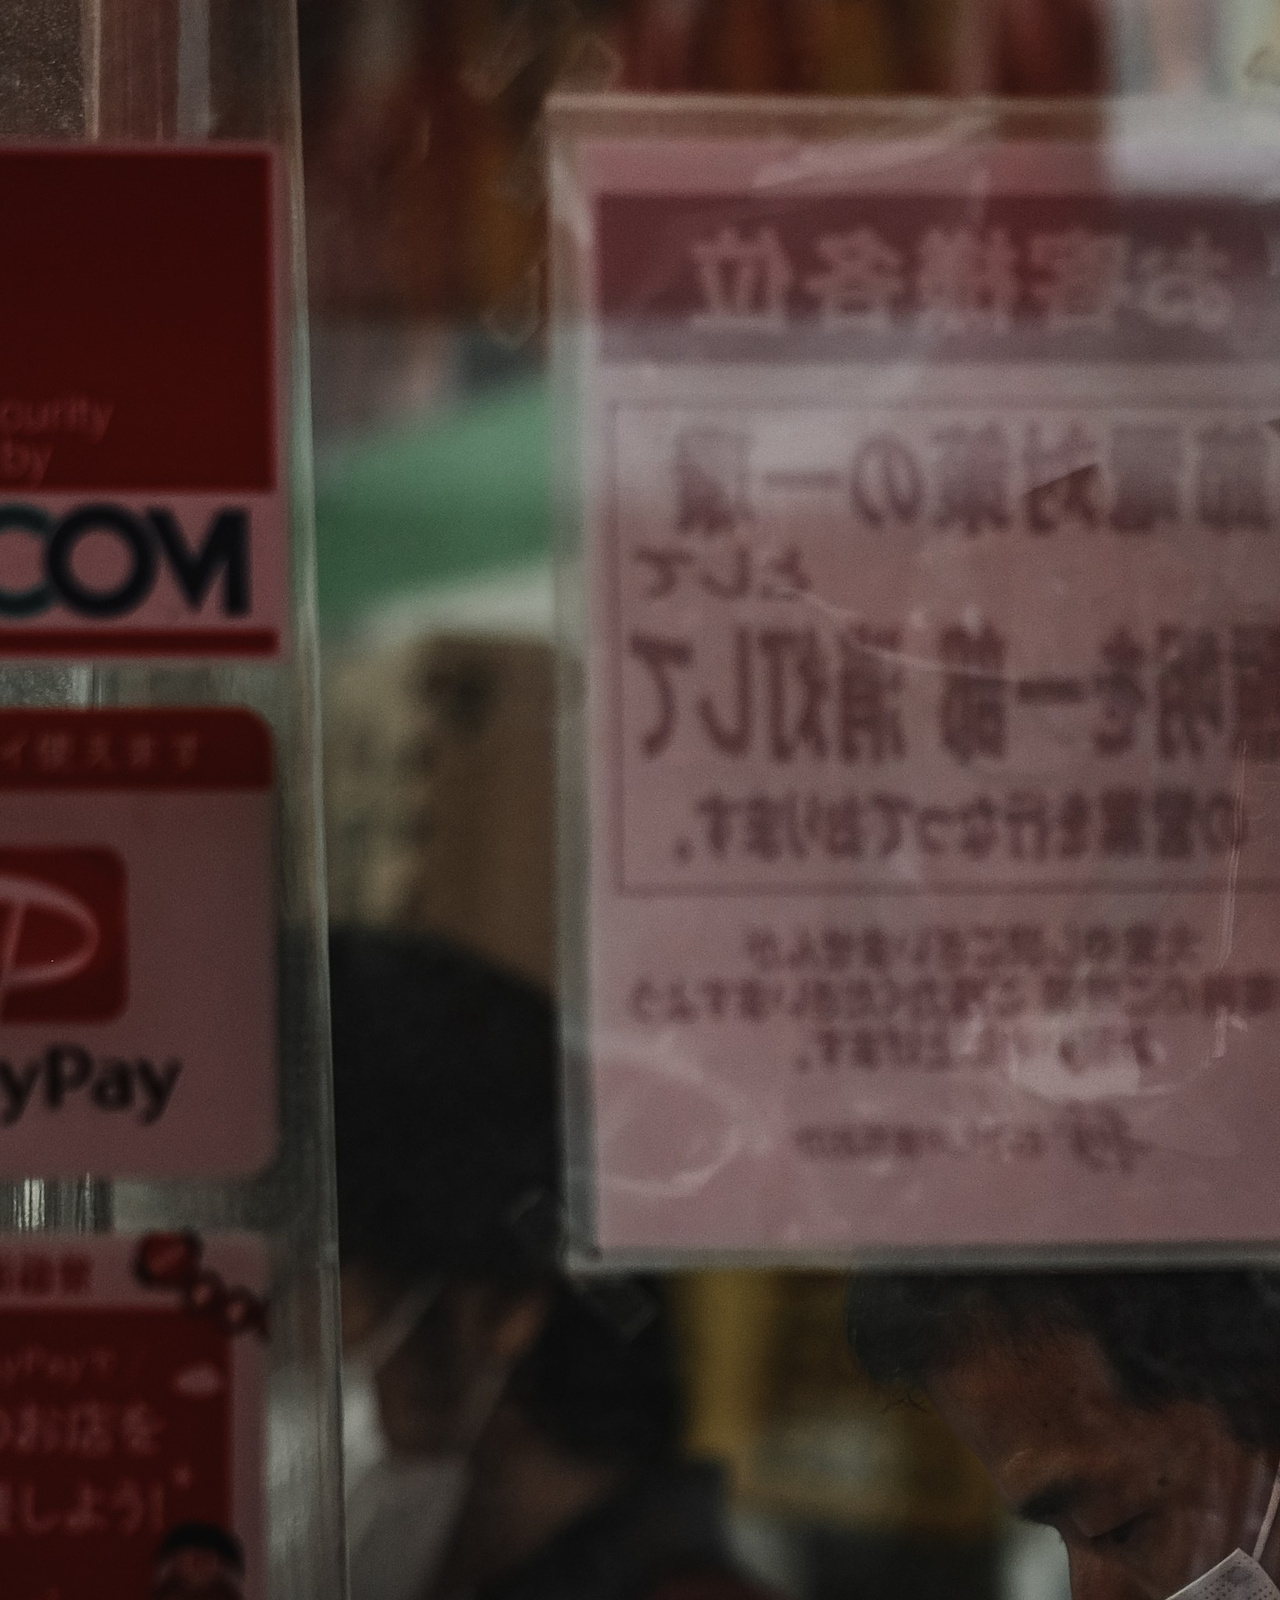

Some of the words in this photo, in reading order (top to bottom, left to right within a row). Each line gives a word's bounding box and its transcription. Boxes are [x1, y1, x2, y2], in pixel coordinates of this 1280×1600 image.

[0, 505, 250, 620] COM
[0, 1043, 181, 1124] yPay
[0, 1400, 166, 1459] お店を
[0, 1478, 167, 1538] しよう!
